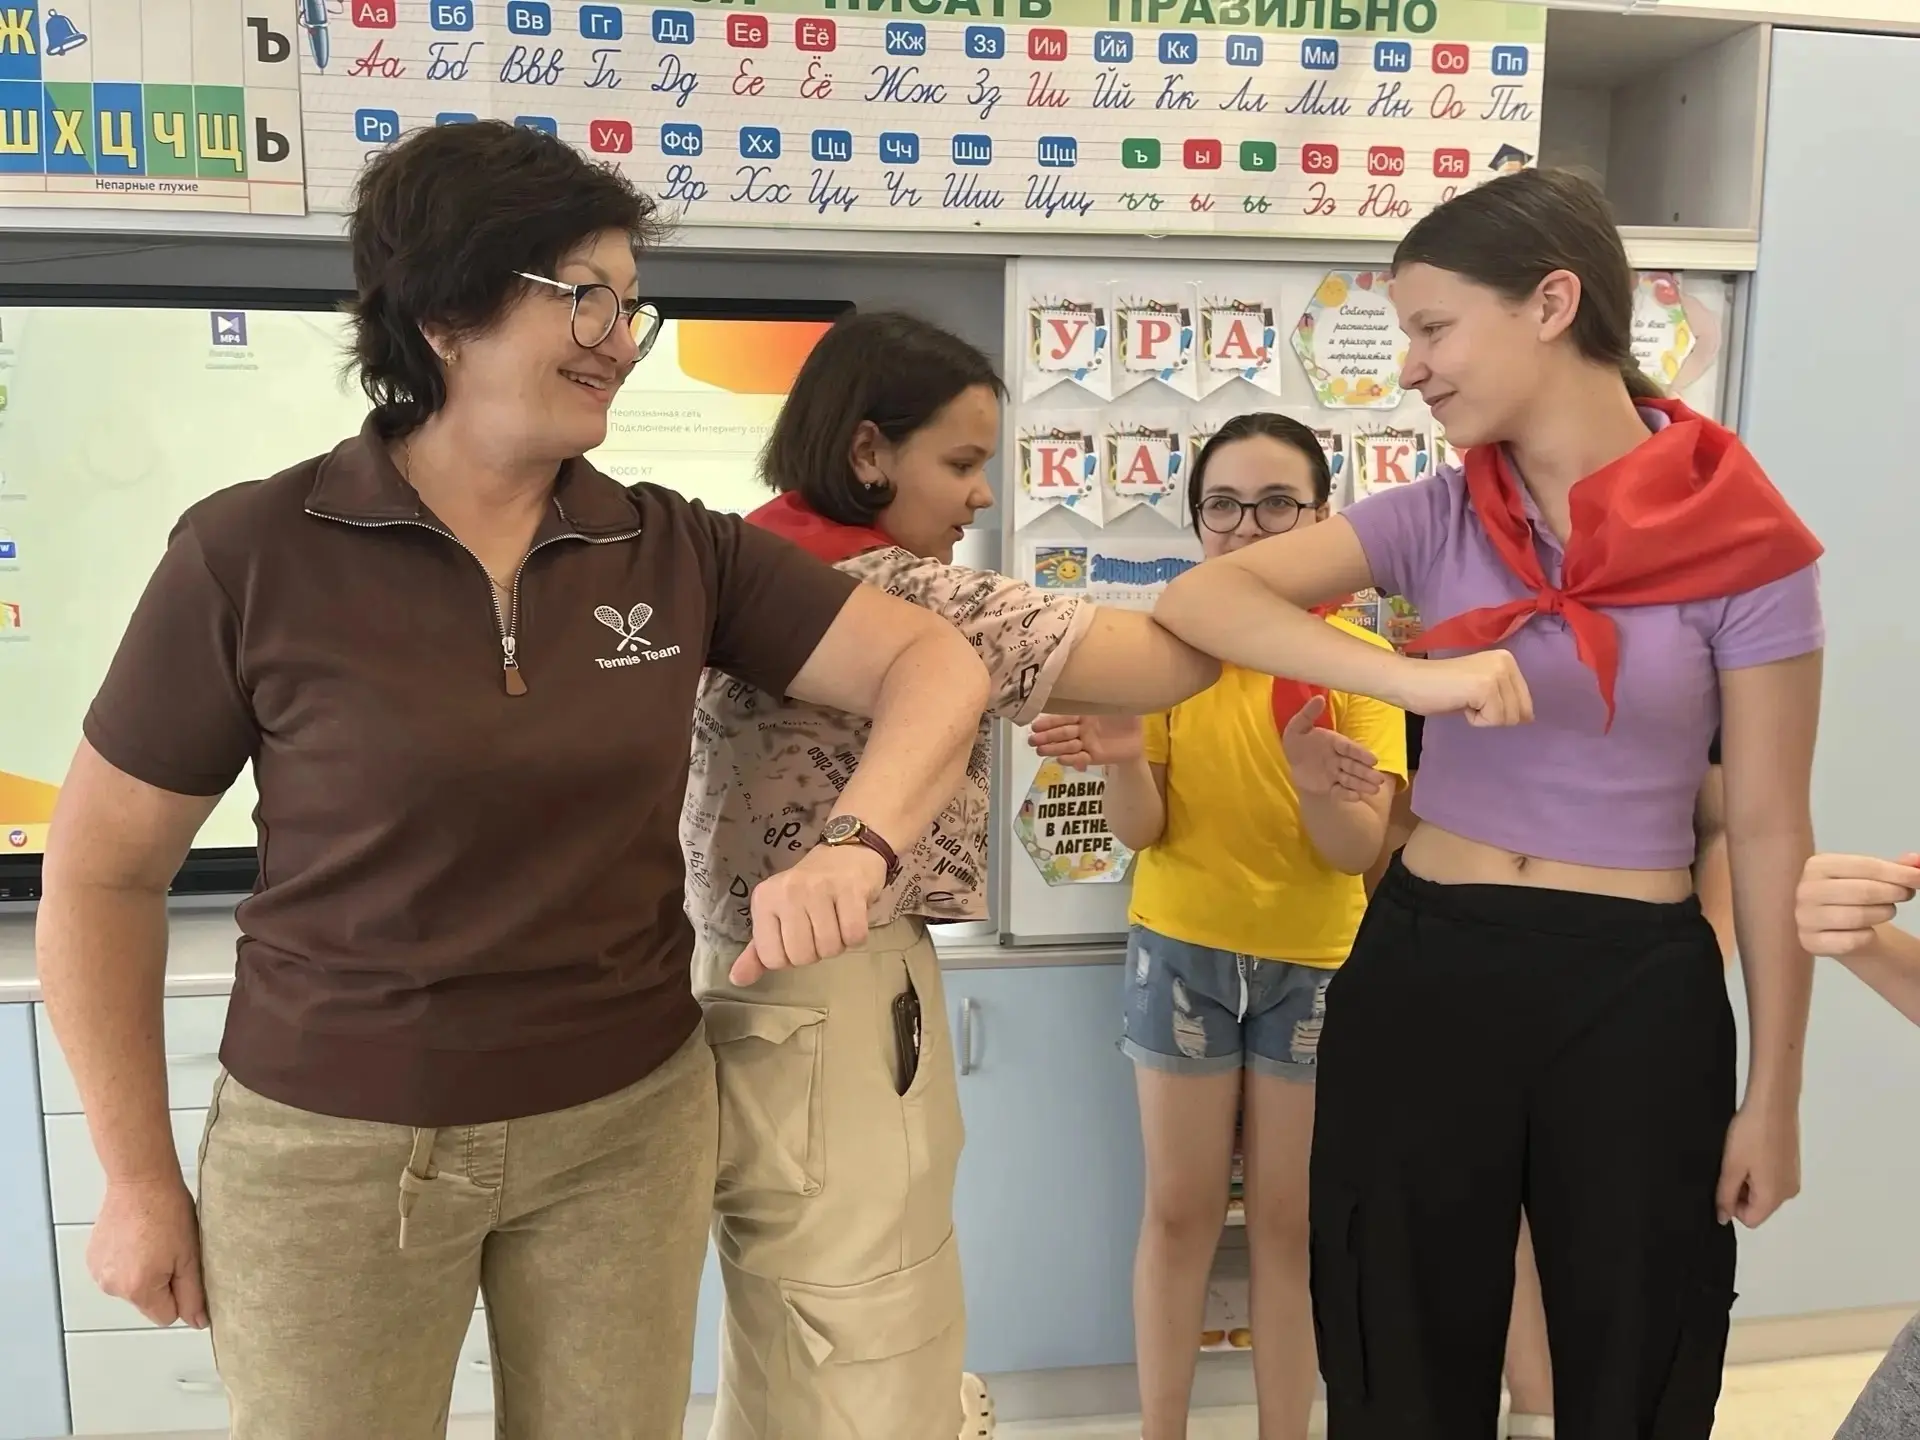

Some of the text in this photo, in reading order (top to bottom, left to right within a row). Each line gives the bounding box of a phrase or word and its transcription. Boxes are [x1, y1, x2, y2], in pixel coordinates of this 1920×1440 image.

[825, 0, 1437, 34] АТЬ ПРАВИЛЬНО
[0, 9, 291, 63] Ж Ъ
[356, 4, 1522, 71] Аа Бб Вв Гг Дд Ее Ёё Жж Зз Ии Йй Кк Лл Мм Нн Оо Пп
[0, 110, 290, 172] Ш Х Ц Ч Щ Ь
[364, 117, 392, 140] Рр
[597, 128, 624, 151] Уу
[664, 131, 700, 154] Фф
[747, 134, 773, 154] Хх
[818, 138, 847, 160] Цц
[887, 140, 911, 158] Чч
[954, 142, 991, 160] Шш
[1039, 144, 1076, 165] Щщ
[1308, 150, 1332, 169] Ээ
[1368, 153, 1404, 172] Юю
[1440, 155, 1463, 173] Яя
[96, 179, 199, 193] Непарные глухие
[1340, 305, 1386, 318] Соблюдай
[1333, 322, 1388, 333] расписание
[220, 334, 240, 343] MP4
[610, 423, 681, 434] Подключение
[694, 424, 746, 435] Интернету
[595, 645, 681, 669] Tennis Team
[1048, 781, 1105, 799] ПРАВИЛ
[1038, 800, 1103, 819] ПОВЕДЕ
[1046, 819, 1112, 837] В ЛЕТНЕ
[1055, 837, 1113, 855] ЛАГЕРЕ
